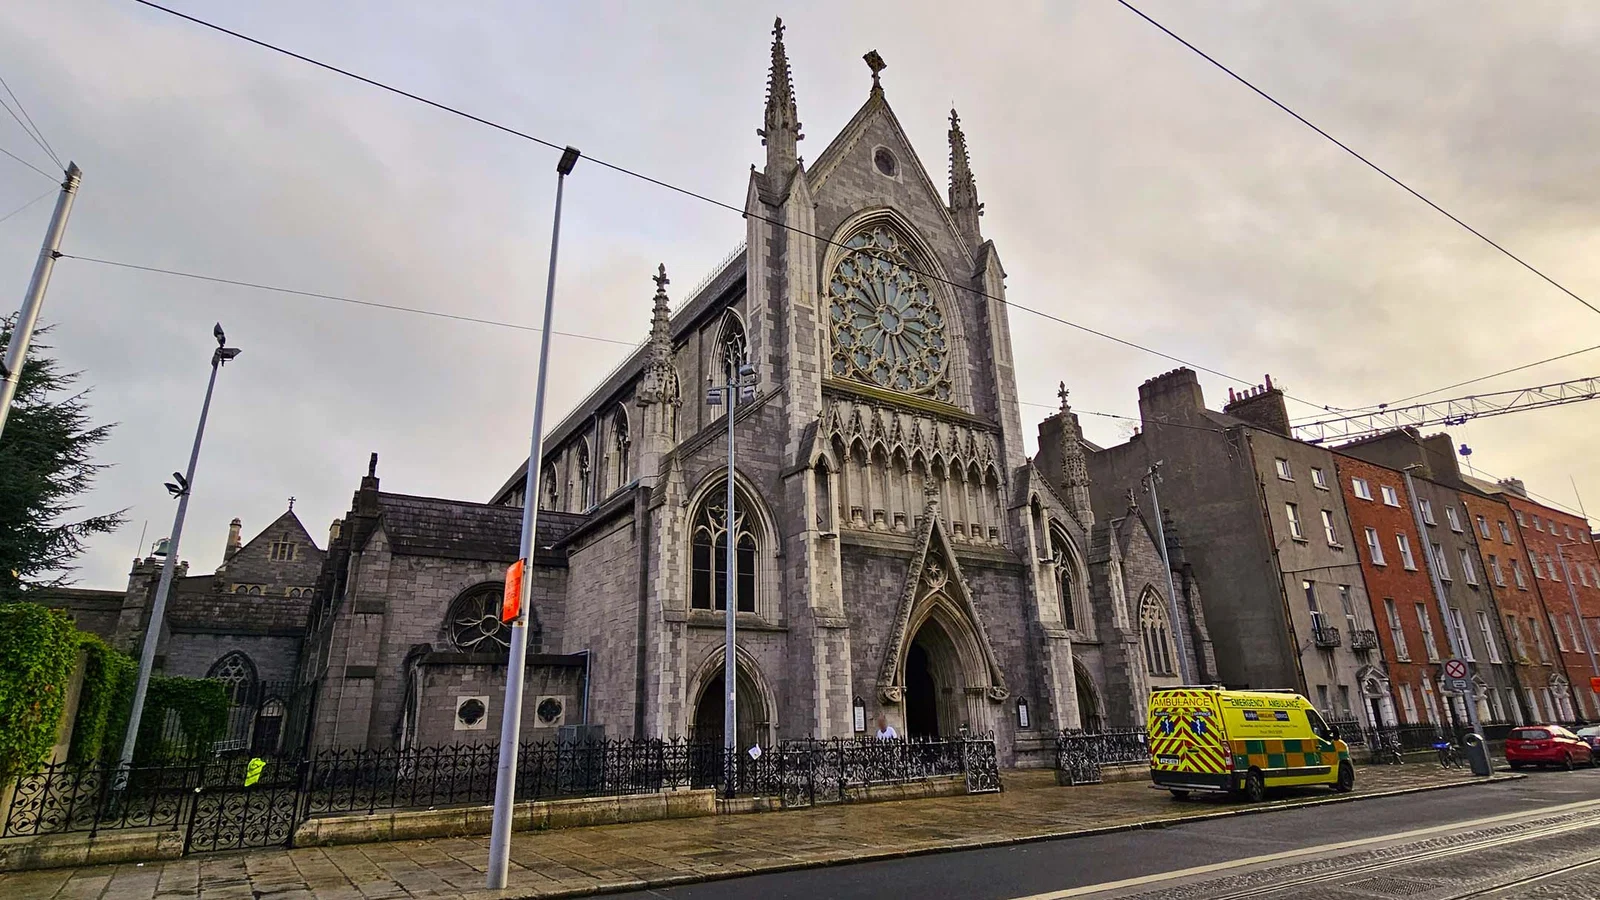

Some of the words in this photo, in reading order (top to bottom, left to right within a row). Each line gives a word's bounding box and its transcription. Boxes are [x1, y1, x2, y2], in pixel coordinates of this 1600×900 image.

[1154, 697, 1210, 707] AMBULANCE
[1231, 698, 1265, 707] EMERGENCY
[1268, 699, 1300, 708] AMBULANCE
